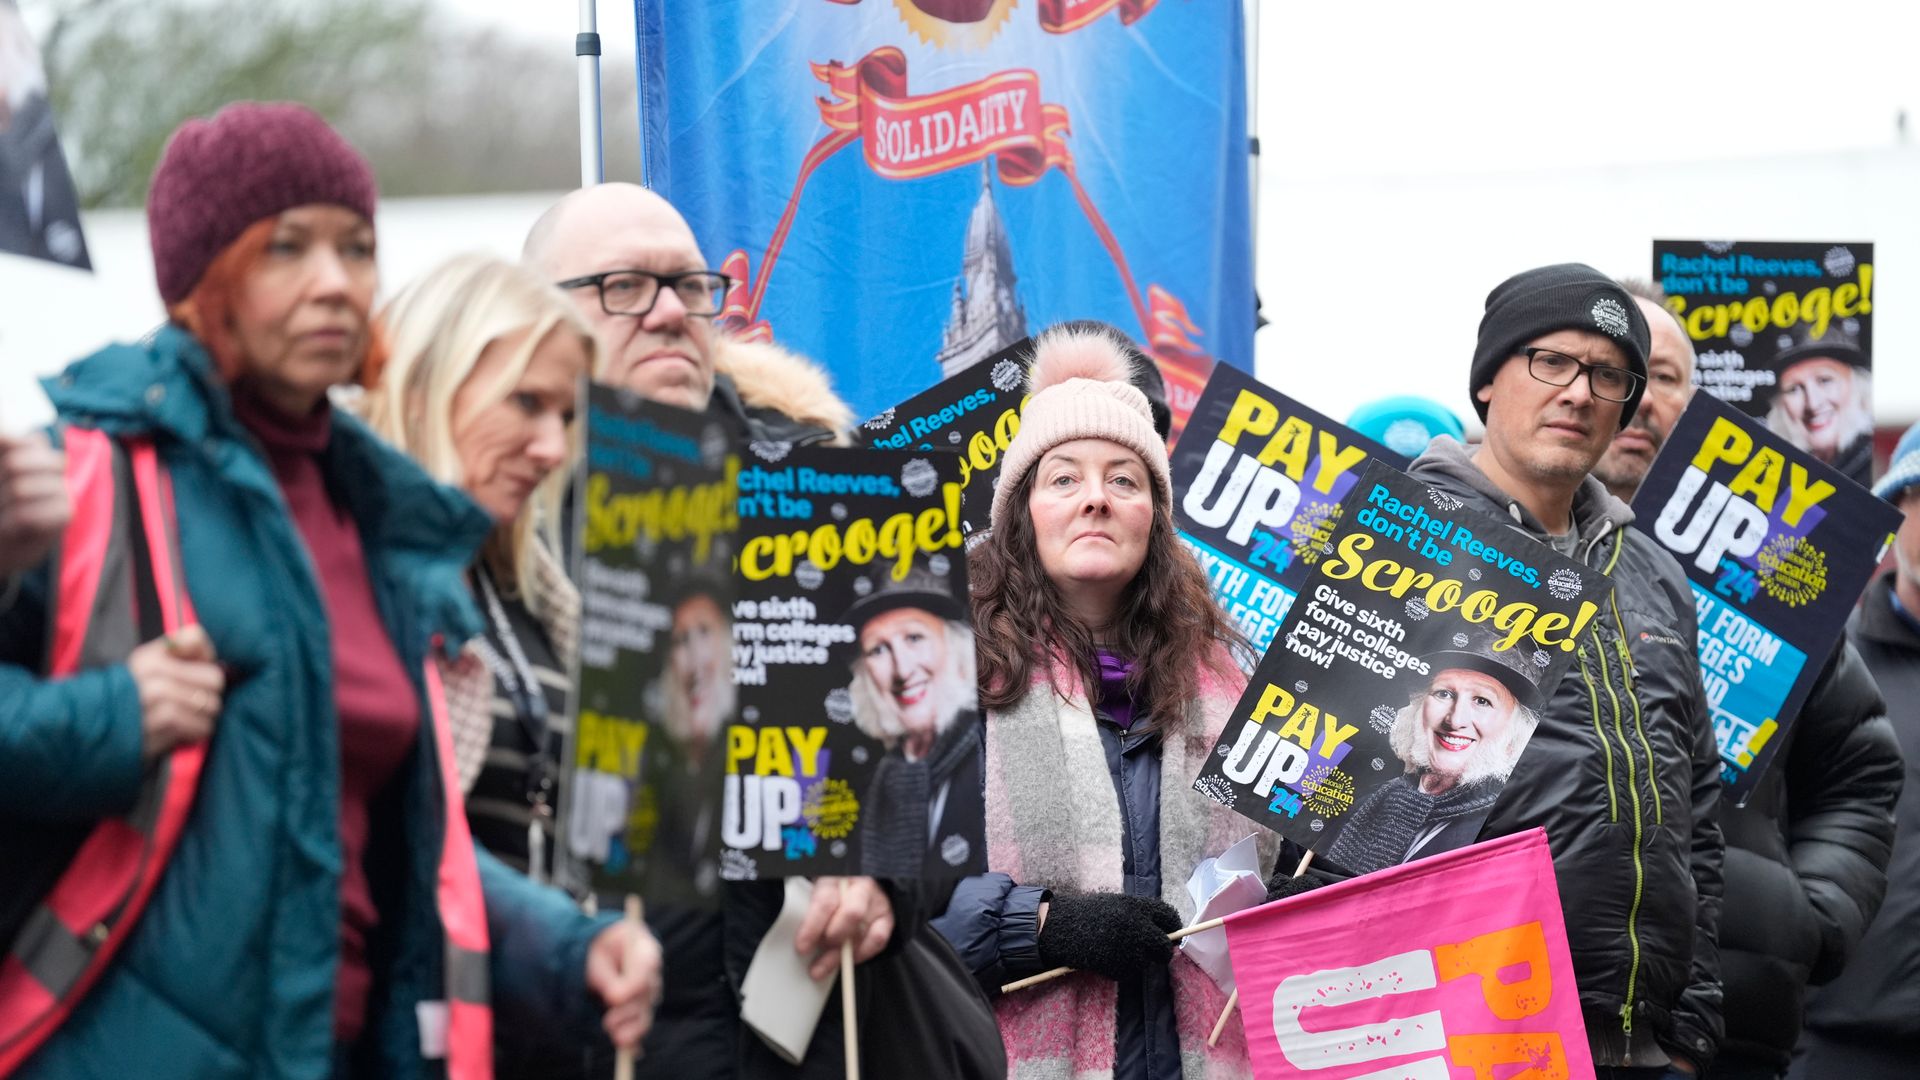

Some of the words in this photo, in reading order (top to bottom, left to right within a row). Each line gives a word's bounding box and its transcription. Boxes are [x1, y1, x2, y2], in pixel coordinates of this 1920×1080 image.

[1661, 253, 1736, 273] Rachel
[1739, 255, 1822, 278] Reeves,
[1721, 274, 1748, 294] be
[909, 388, 996, 439] Reeves,
[1217, 388, 1368, 495] PAY
[737, 465, 794, 492] chel
[797, 467, 900, 497] Reeves,
[1183, 439, 1301, 547] UP
[1691, 416, 1837, 528] PAY
[736, 482, 963, 582] crooge!
[738, 493, 776, 517] n't
[778, 494, 814, 519] be
[1654, 465, 1769, 575] UP
[1357, 508, 1422, 551] don't
[1420, 537, 1454, 567] be
[1368, 484, 1454, 540] Rachel
[1451, 527, 1542, 589] Reeves,
[1180, 537, 1250, 599] XTH
[1321, 533, 1598, 652] Scrooge!
[1758, 551, 1827, 592] education
[732, 600, 758, 619] ve
[759, 595, 817, 620] sixth
[732, 622, 765, 641] rm
[765, 619, 856, 647] colleges
[1315, 585, 1356, 615] Give
[1356, 609, 1406, 642] sixth
[751, 640, 829, 665] justice
[1285, 639, 1335, 669] now!
[1293, 620, 1332, 648] pay
[1326, 635, 1396, 680] justice
[1305, 601, 1352, 636] form
[1352, 629, 1431, 676] colleges
[1697, 629, 1753, 685] EGES
[1711, 608, 1782, 667] FORM
[731, 662, 767, 686] ow!
[1250, 683, 1360, 760] PAY
[725, 725, 828, 777] PAY
[1222, 720, 1309, 798] UP
[1268, 785, 1299, 819] '24
[1301, 779, 1354, 805] education
[1315, 794, 1335, 805] union
[1318, 776, 1344, 790] national
[721, 774, 802, 851] UP
[1273, 949, 1450, 1080] U
